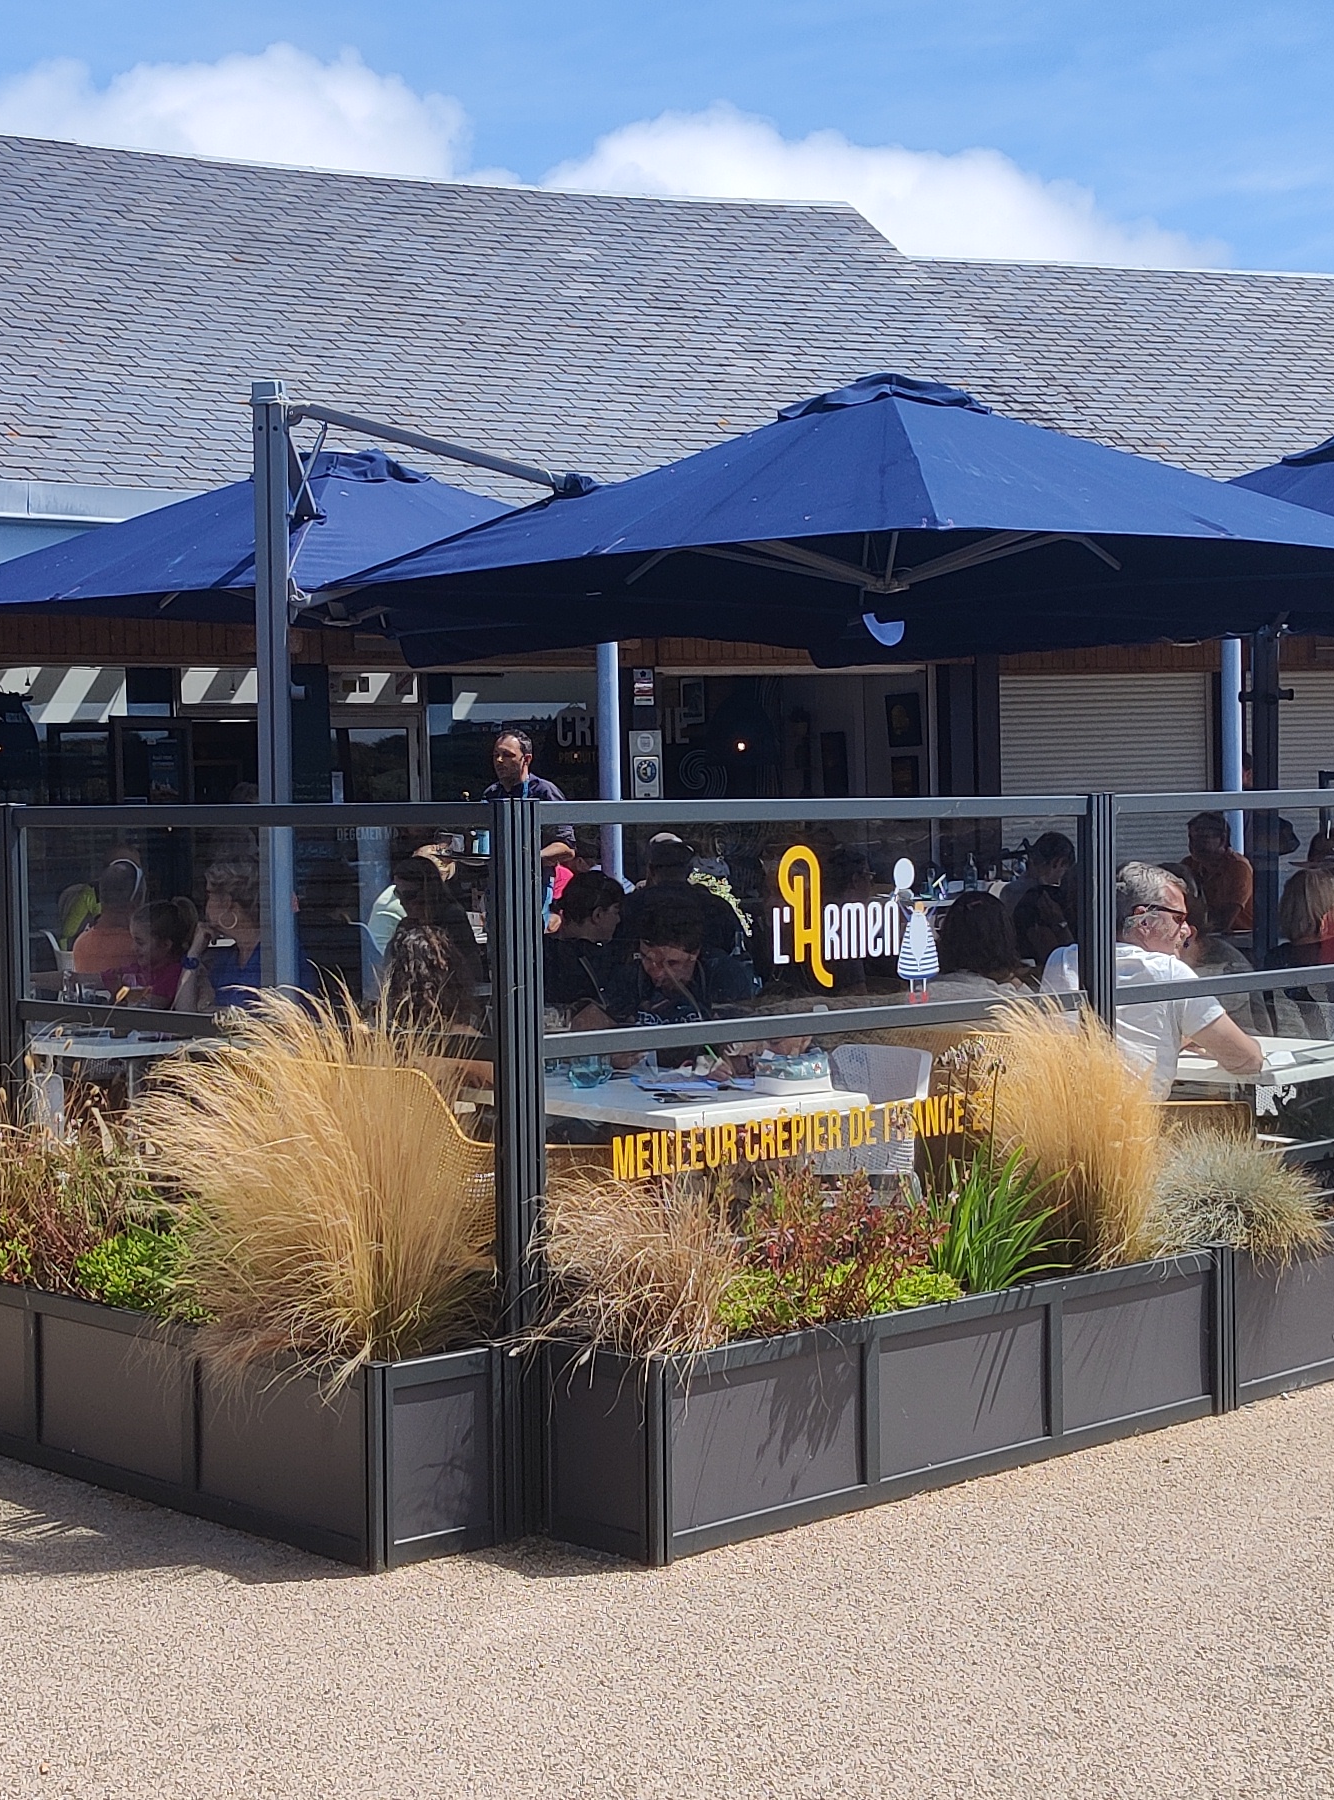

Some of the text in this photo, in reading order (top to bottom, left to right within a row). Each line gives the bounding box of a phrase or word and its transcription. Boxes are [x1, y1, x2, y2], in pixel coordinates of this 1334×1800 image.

[612, 1122, 737, 1180] MEILLEUR
[744, 1106, 842, 1163] CRÊPIER
[849, 1104, 877, 1148] DE
